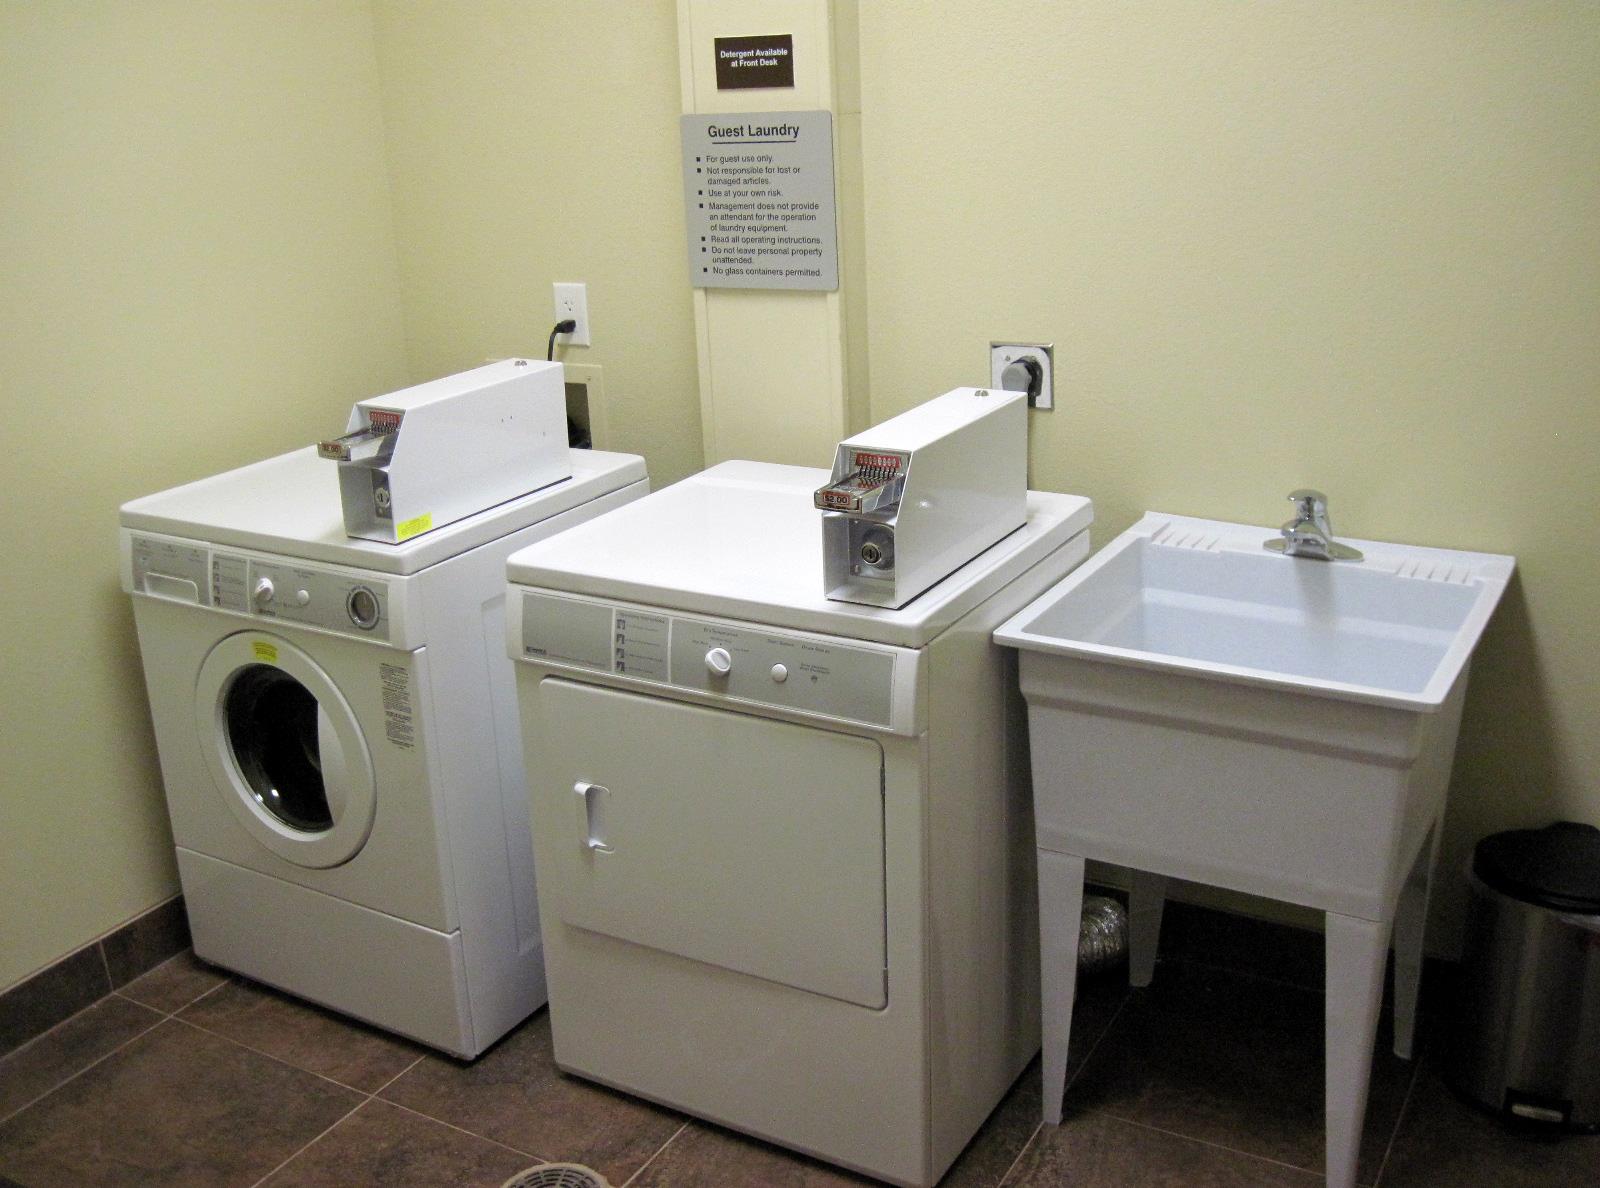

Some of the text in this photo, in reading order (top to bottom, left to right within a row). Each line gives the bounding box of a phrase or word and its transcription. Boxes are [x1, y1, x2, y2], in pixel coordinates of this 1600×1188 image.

[720, 48, 788, 59] Detergent Available
[740, 59, 758, 67] Front
[708, 124, 800, 138] Guest Laundry
[709, 203, 755, 211] Management
[742, 237, 775, 245] operating
[725, 267, 743, 275] glass
[786, 268, 822, 276] permitted.
